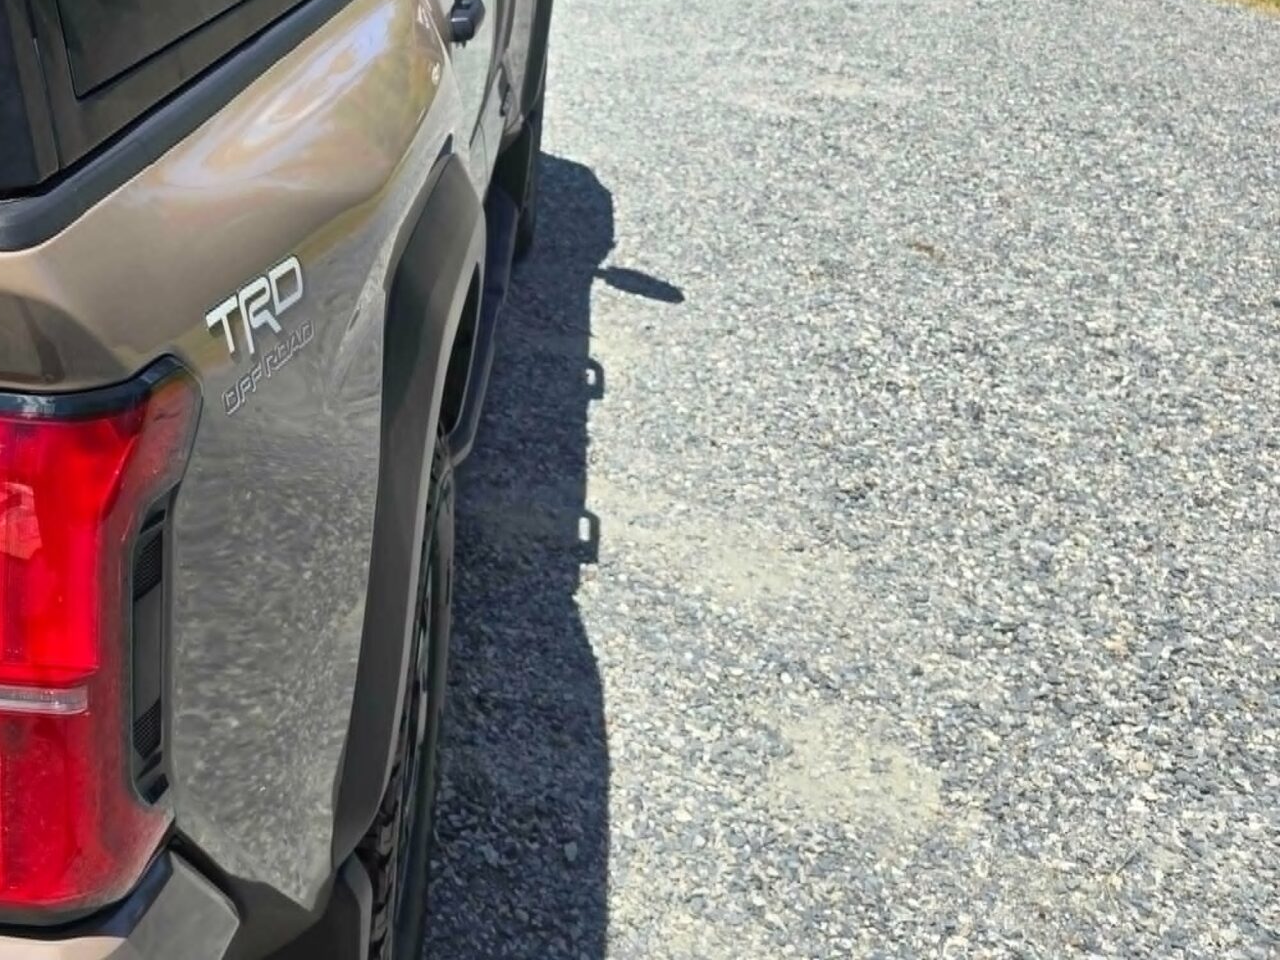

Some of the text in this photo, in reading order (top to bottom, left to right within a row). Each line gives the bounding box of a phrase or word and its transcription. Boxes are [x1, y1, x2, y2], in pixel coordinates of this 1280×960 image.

[205, 255, 304, 355] TRD
[222, 320, 315, 416] OFF ROAD
